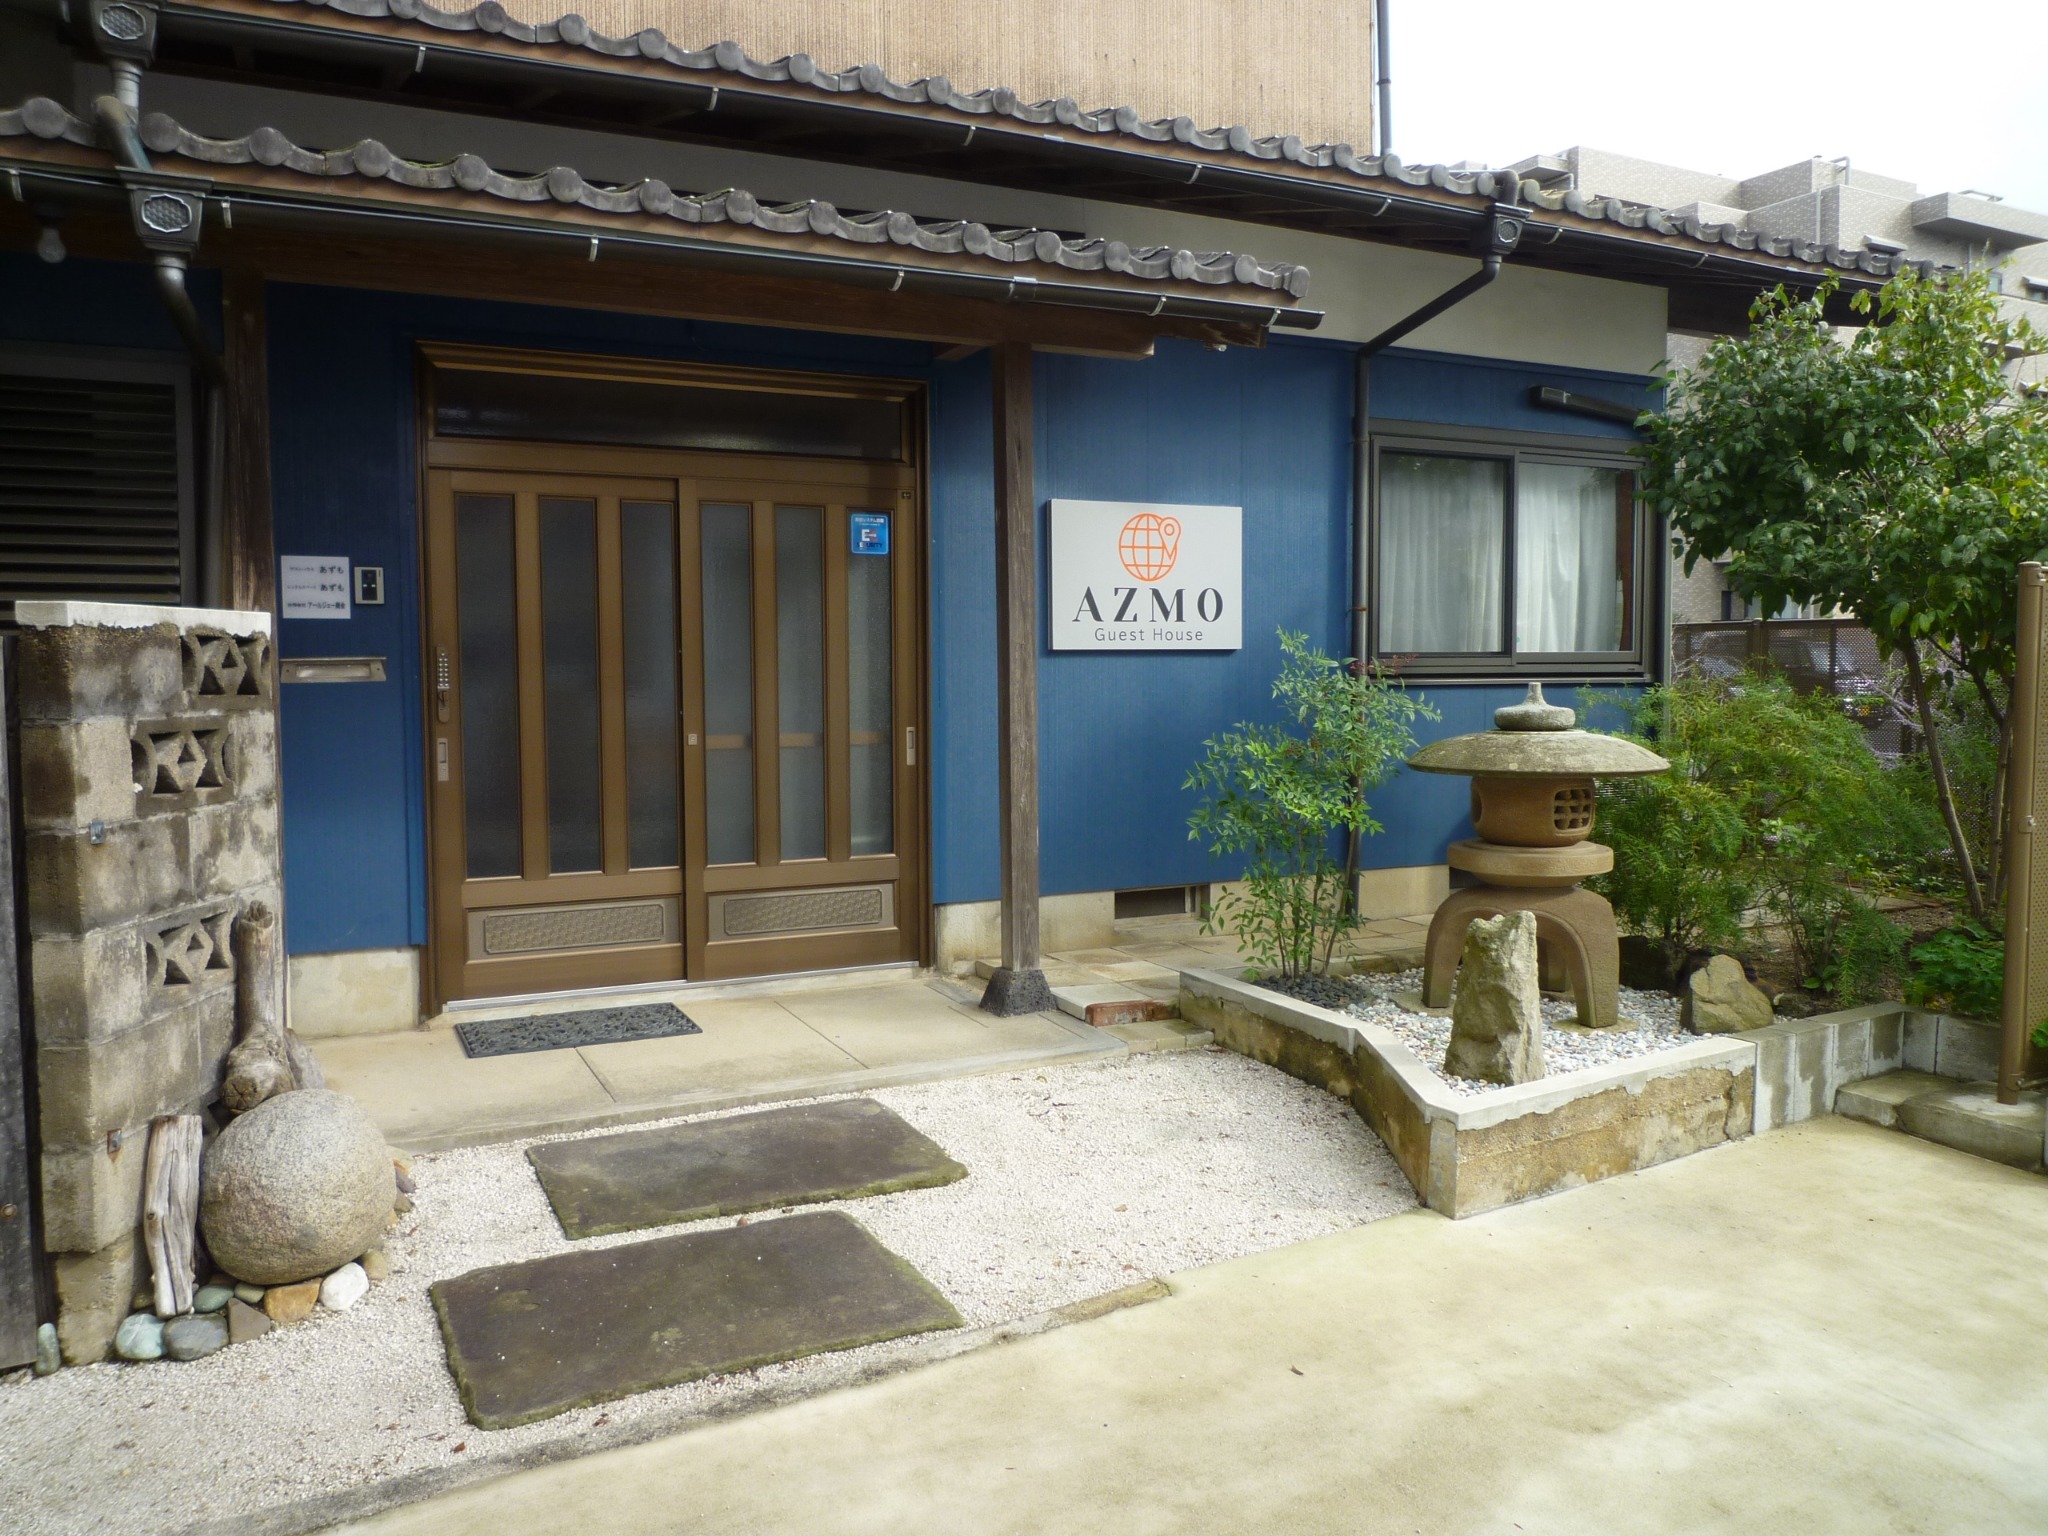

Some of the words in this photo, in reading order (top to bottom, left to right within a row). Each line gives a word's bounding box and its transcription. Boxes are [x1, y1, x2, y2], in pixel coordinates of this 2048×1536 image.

[319, 566, 344, 574] あずも
[320, 584, 345, 592] あずも
[1072, 586, 1223, 622] AZMO
[1095, 628, 1145, 641] Guest
[1153, 628, 1203, 641] House
